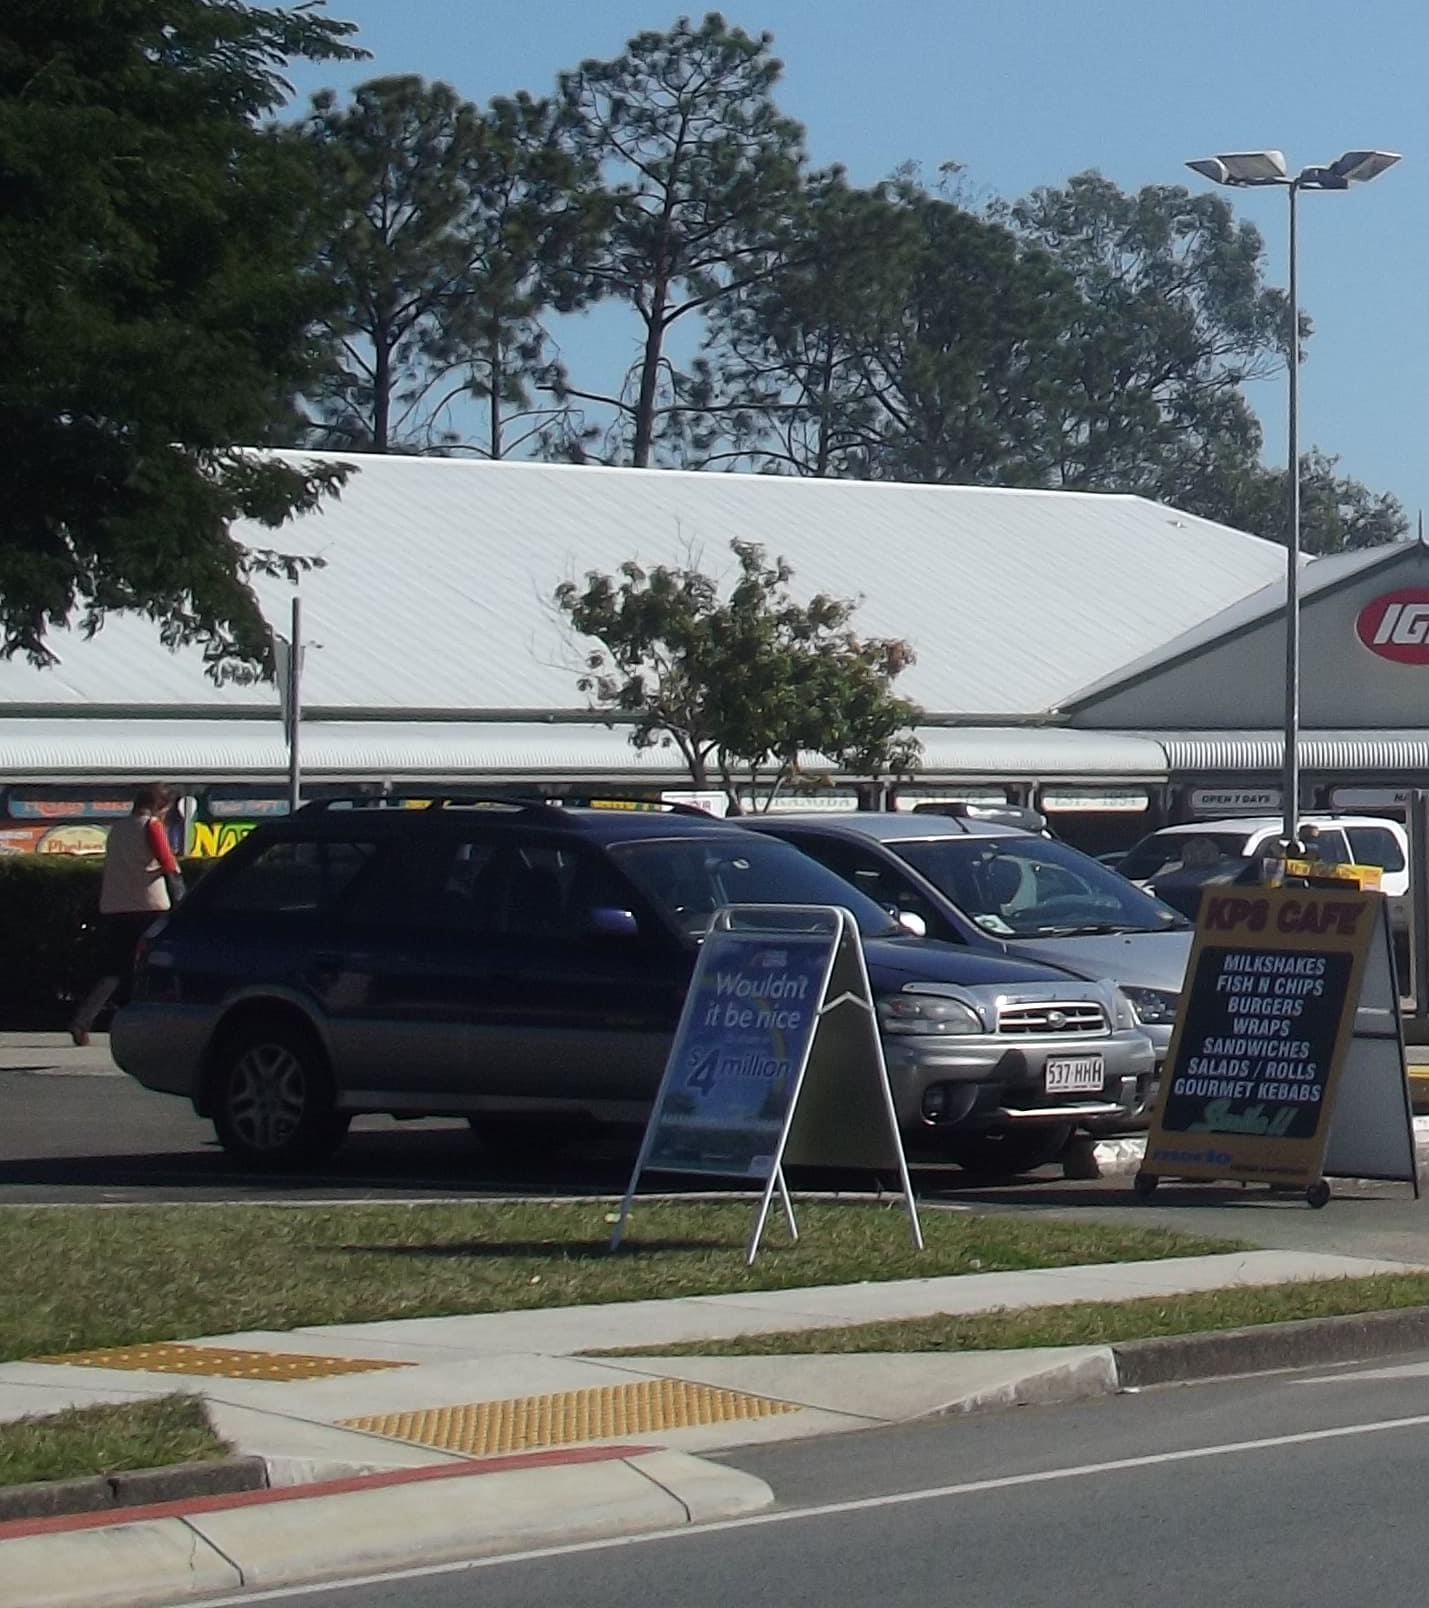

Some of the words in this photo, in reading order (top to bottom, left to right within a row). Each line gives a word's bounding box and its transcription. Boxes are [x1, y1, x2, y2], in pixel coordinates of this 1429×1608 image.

[1277, 899, 1366, 935] CAFE
[1223, 954, 1326, 976] MILKSHAKES
[1216, 975, 1251, 993] FISH
[1257, 976, 1271, 994] N
[1274, 978, 1325, 997] CHIPS
[705, 1002, 719, 1027] it
[724, 1002, 752, 1029] be
[754, 1005, 801, 1030] nice
[1227, 996, 1304, 1017] BURGERS
[1232, 1017, 1291, 1037] WRAPS
[1203, 1037, 1310, 1059] SANDWICHES
[720, 1054, 792, 1079] million
[1048, 1062, 1071, 1084] 537
[1074, 1060, 1102, 1083] HHH
[1187, 1057, 1251, 1077] SALADS
[1264, 1061, 1317, 1081] ROLLS
[1174, 1077, 1254, 1098] GOURMET
[1257, 1081, 1321, 1102] KEBABS
